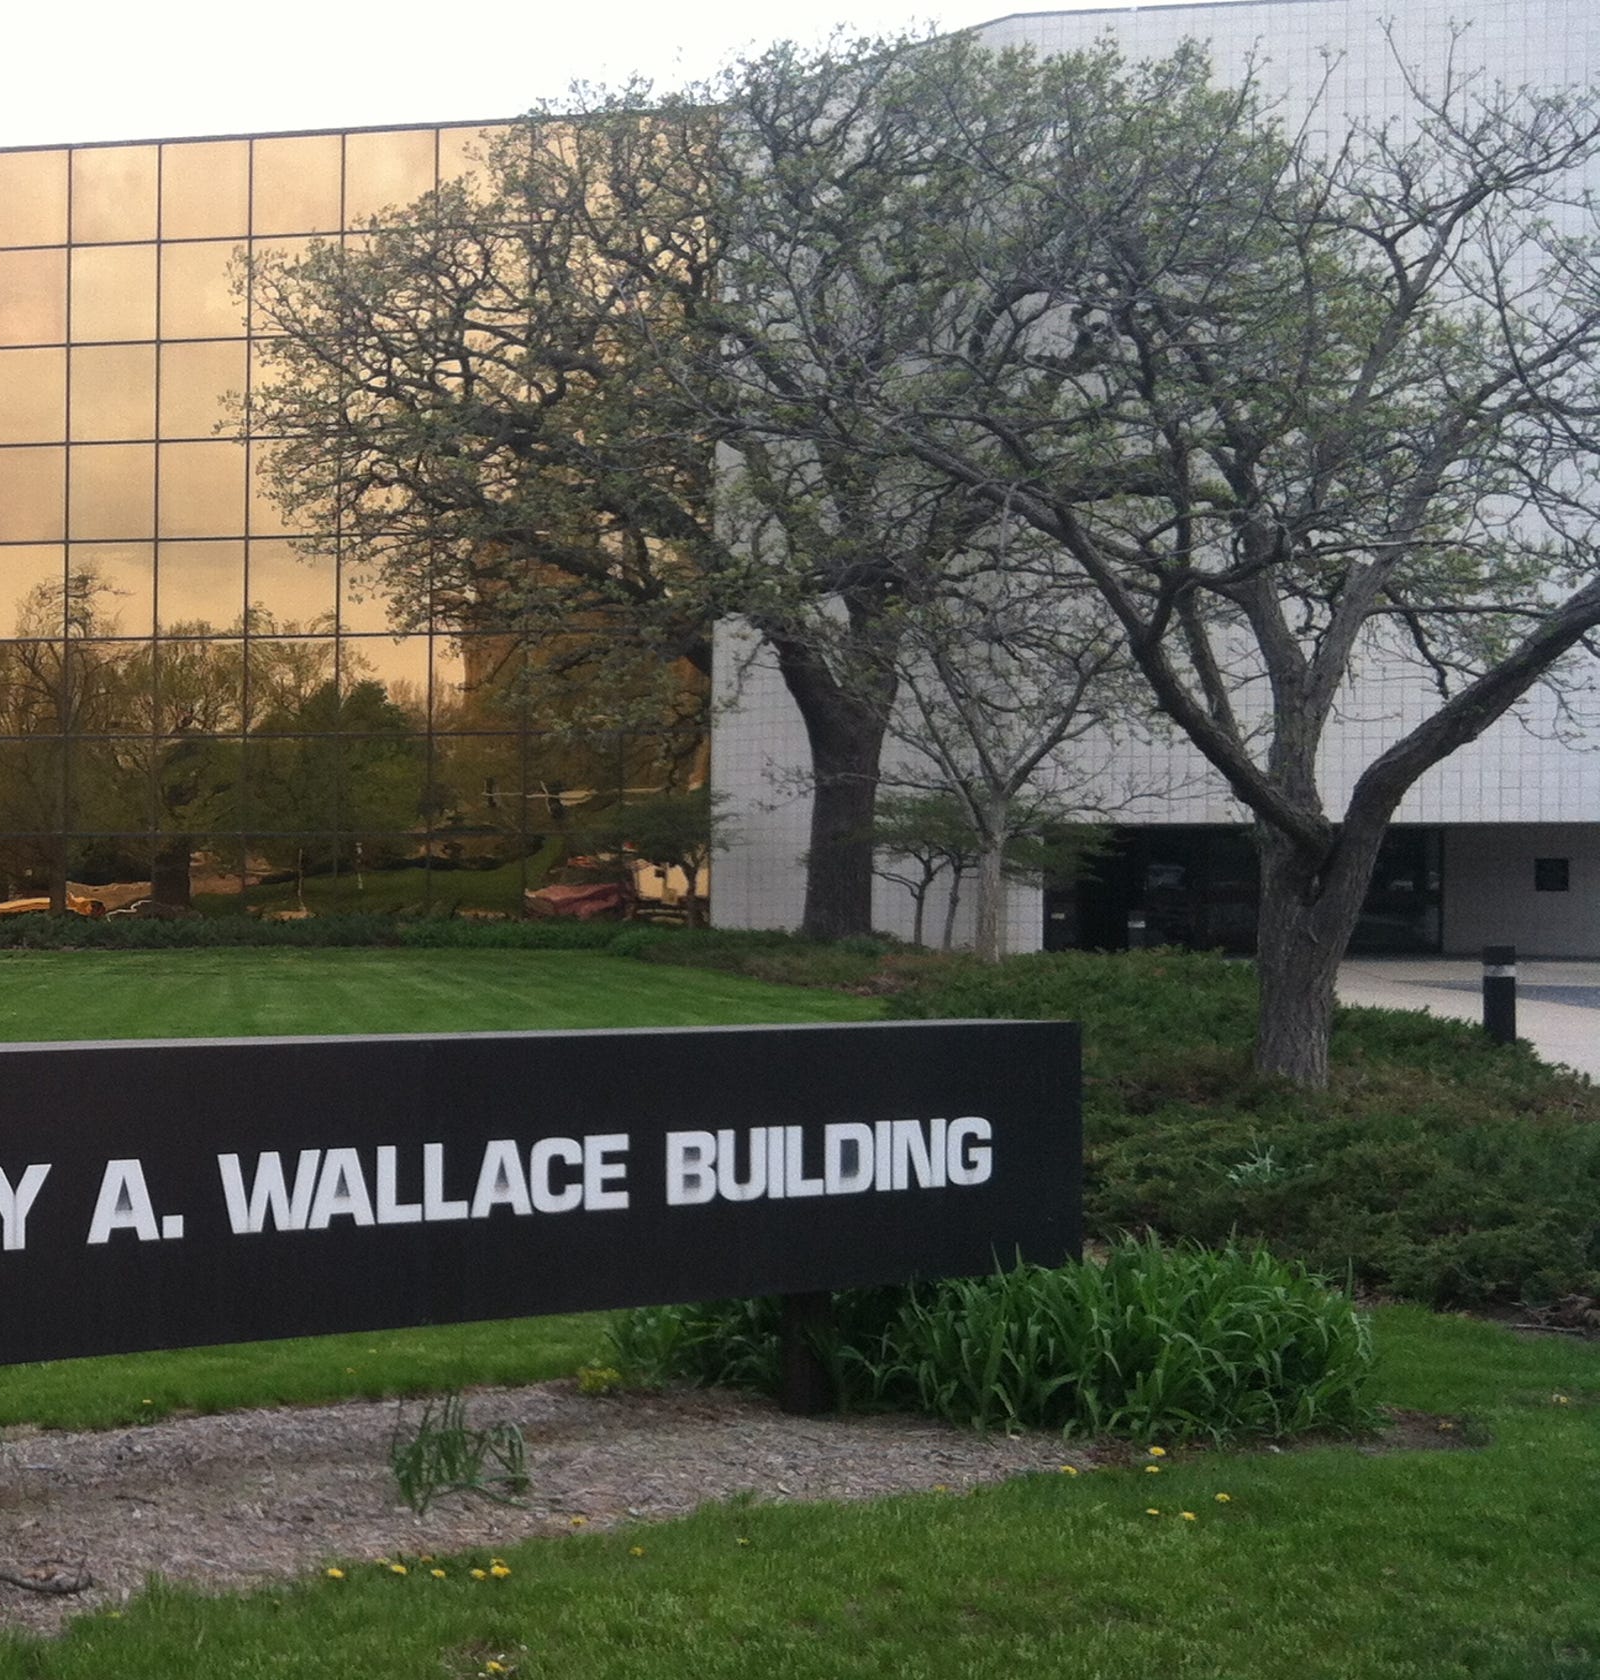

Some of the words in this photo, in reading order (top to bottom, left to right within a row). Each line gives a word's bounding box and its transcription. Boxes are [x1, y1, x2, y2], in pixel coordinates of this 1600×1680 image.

[86, 1158, 185, 1245] A.
[216, 1132, 630, 1235] WALLACE
[665, 1115, 994, 1206] BUILDING
